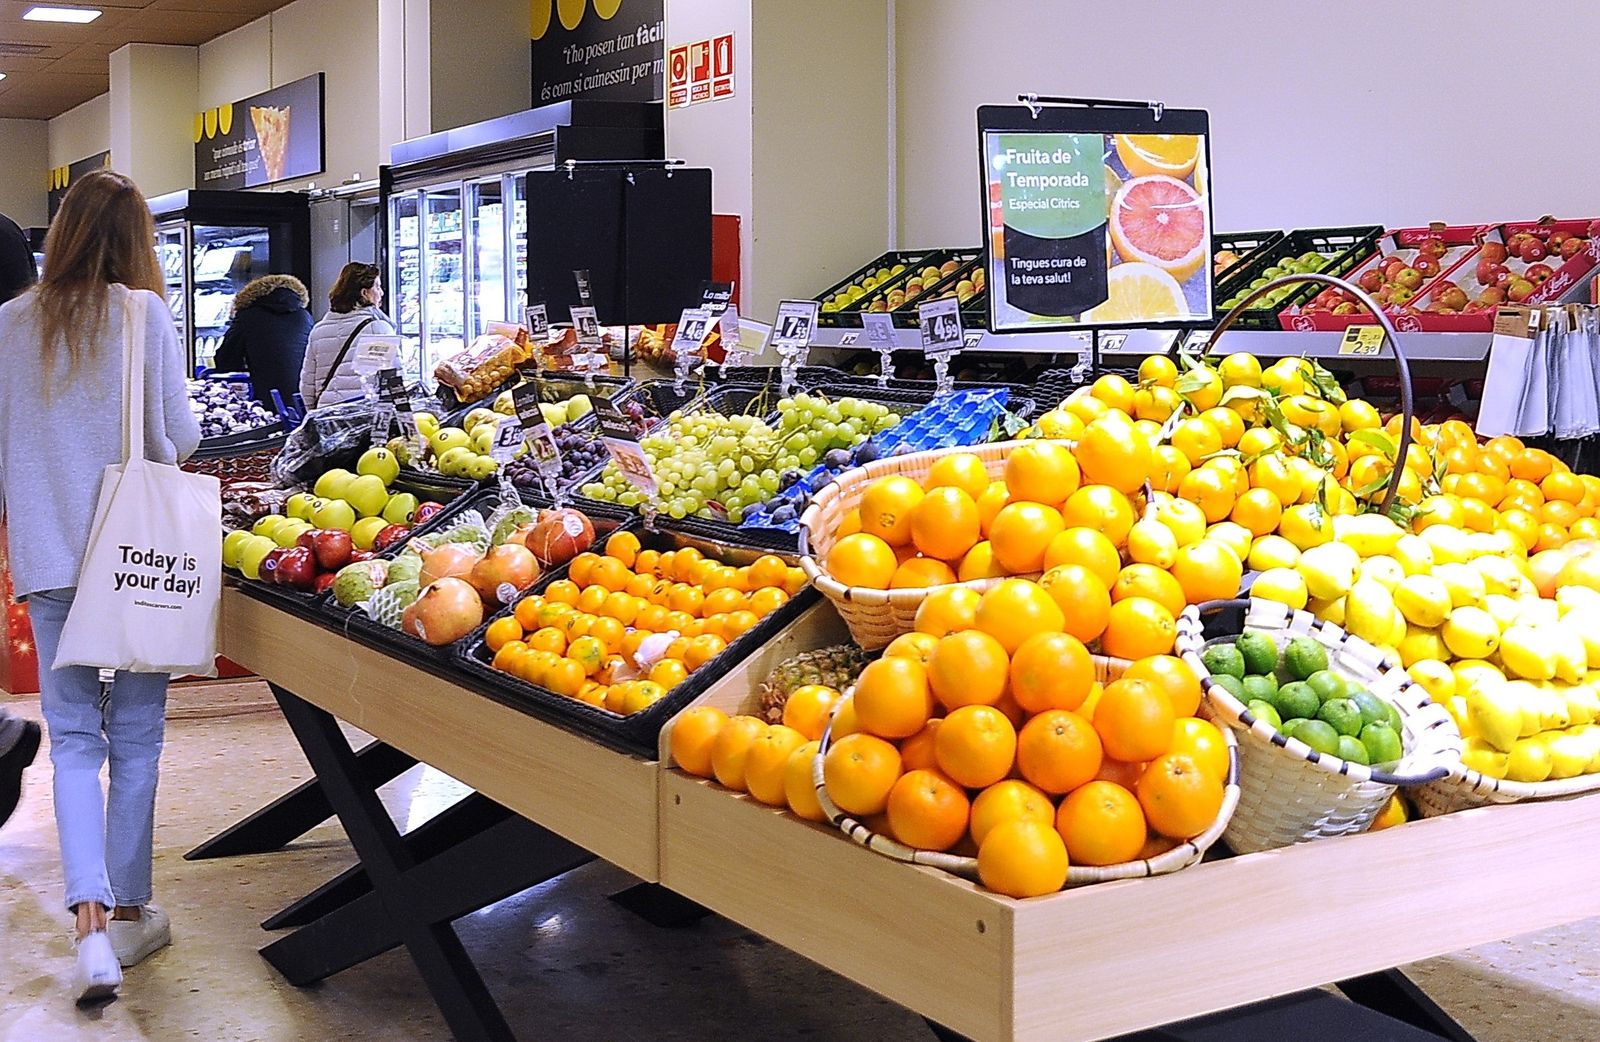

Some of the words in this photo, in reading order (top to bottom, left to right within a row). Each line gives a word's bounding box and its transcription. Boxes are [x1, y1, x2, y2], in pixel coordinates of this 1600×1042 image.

[585, 40, 615, 64] posen
[616, 33, 635, 51] tan
[636, 21, 664, 46] fàcil
[541, 82, 551, 101] és
[552, 80, 572, 97] com
[573, 73, 583, 92] si
[583, 63, 631, 91] cuinessin
[632, 61, 652, 84] per
[1006, 149, 1050, 165] Fruita
[1051, 149, 1072, 164] de
[1007, 172, 1089, 191] Temporada
[1009, 198, 1049, 211] Especial
[1011, 257, 1050, 271] Tingues
[1050, 259, 1073, 268] cura
[1073, 257, 1087, 267] de
[1011, 273, 1021, 285] la
[1022, 274, 1044, 284] teva
[1044, 272, 1071, 284] salut!
[934, 316, 958, 341] 4,99
[118, 545, 178, 574] Today
[183, 552, 197, 571] is
[114, 572, 160, 592] your
[163, 573, 201, 599] day!
